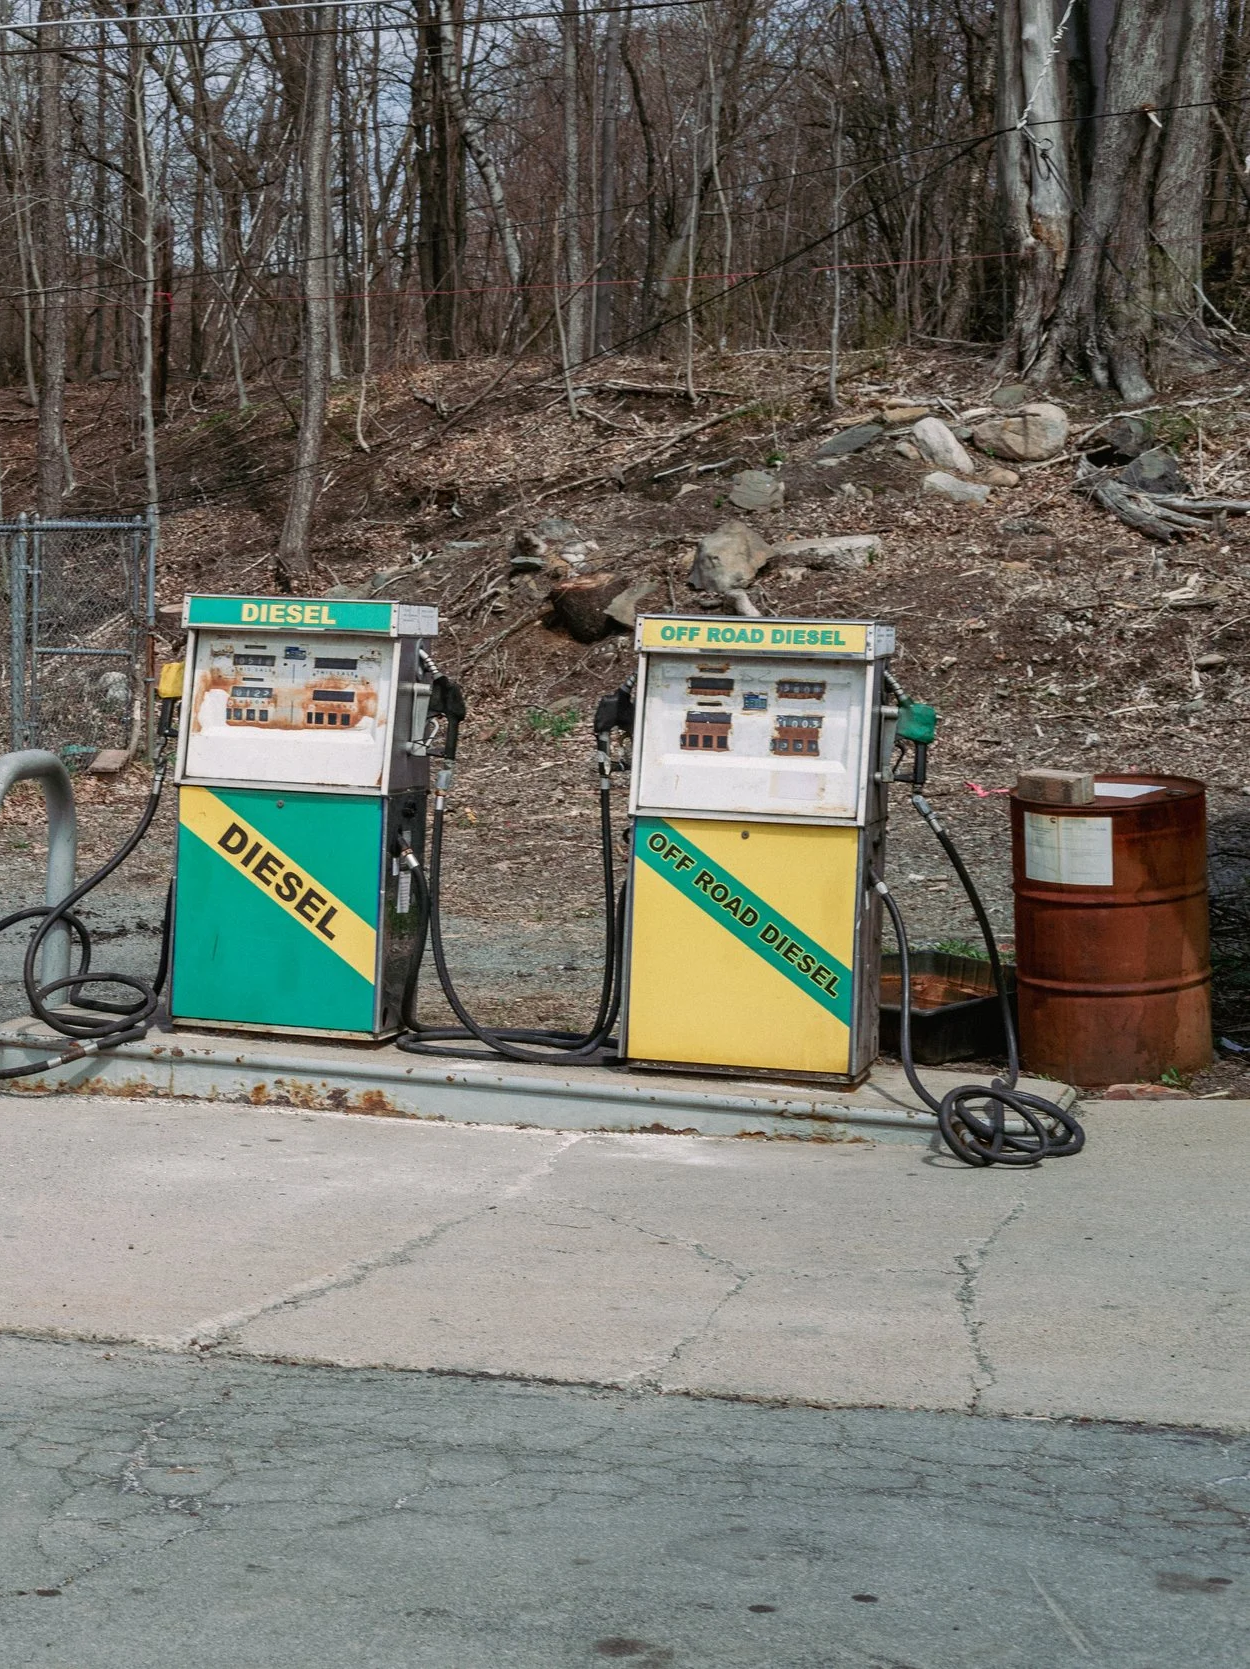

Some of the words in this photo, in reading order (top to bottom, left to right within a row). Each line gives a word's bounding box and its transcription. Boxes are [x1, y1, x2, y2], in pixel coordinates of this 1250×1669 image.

[241, 603, 337, 625] DIESEL
[660, 625, 701, 642] OFF
[706, 627, 765, 644] ROAD
[771, 629, 846, 646] DIESEL
[217, 822, 339, 941] DIESEL
[647, 832, 696, 872] OFF
[693, 868, 760, 928] ROAD
[758, 922, 841, 999] DIESEL
